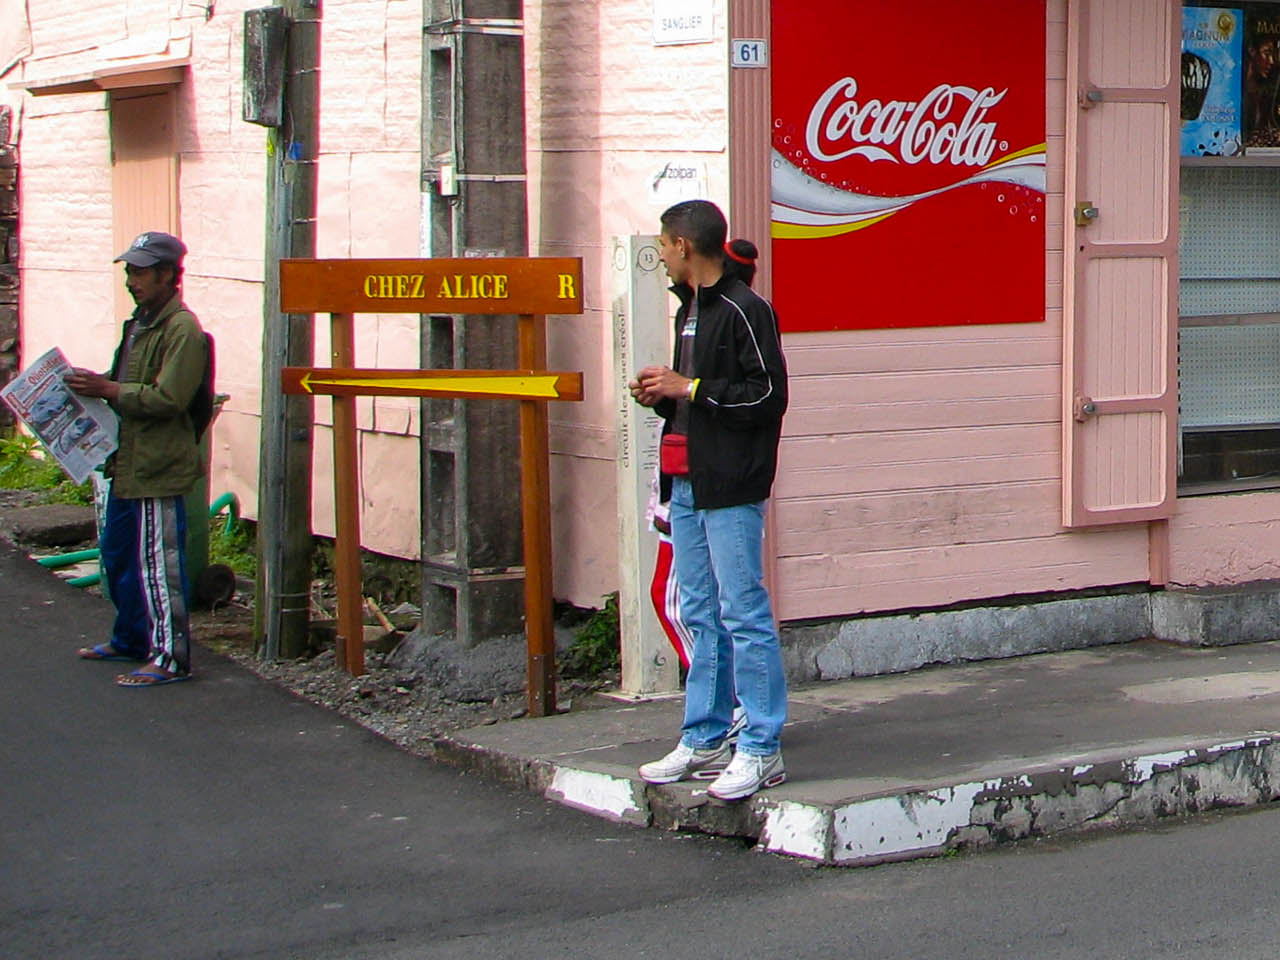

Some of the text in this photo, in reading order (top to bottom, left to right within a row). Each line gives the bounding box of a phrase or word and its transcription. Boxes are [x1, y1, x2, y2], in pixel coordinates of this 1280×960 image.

[741, 44, 759, 62] 61
[806, 76, 1008, 167] Coca-Cola
[645, 253, 653, 263] 13
[364, 274, 576, 298] CHEZ ALICE R
